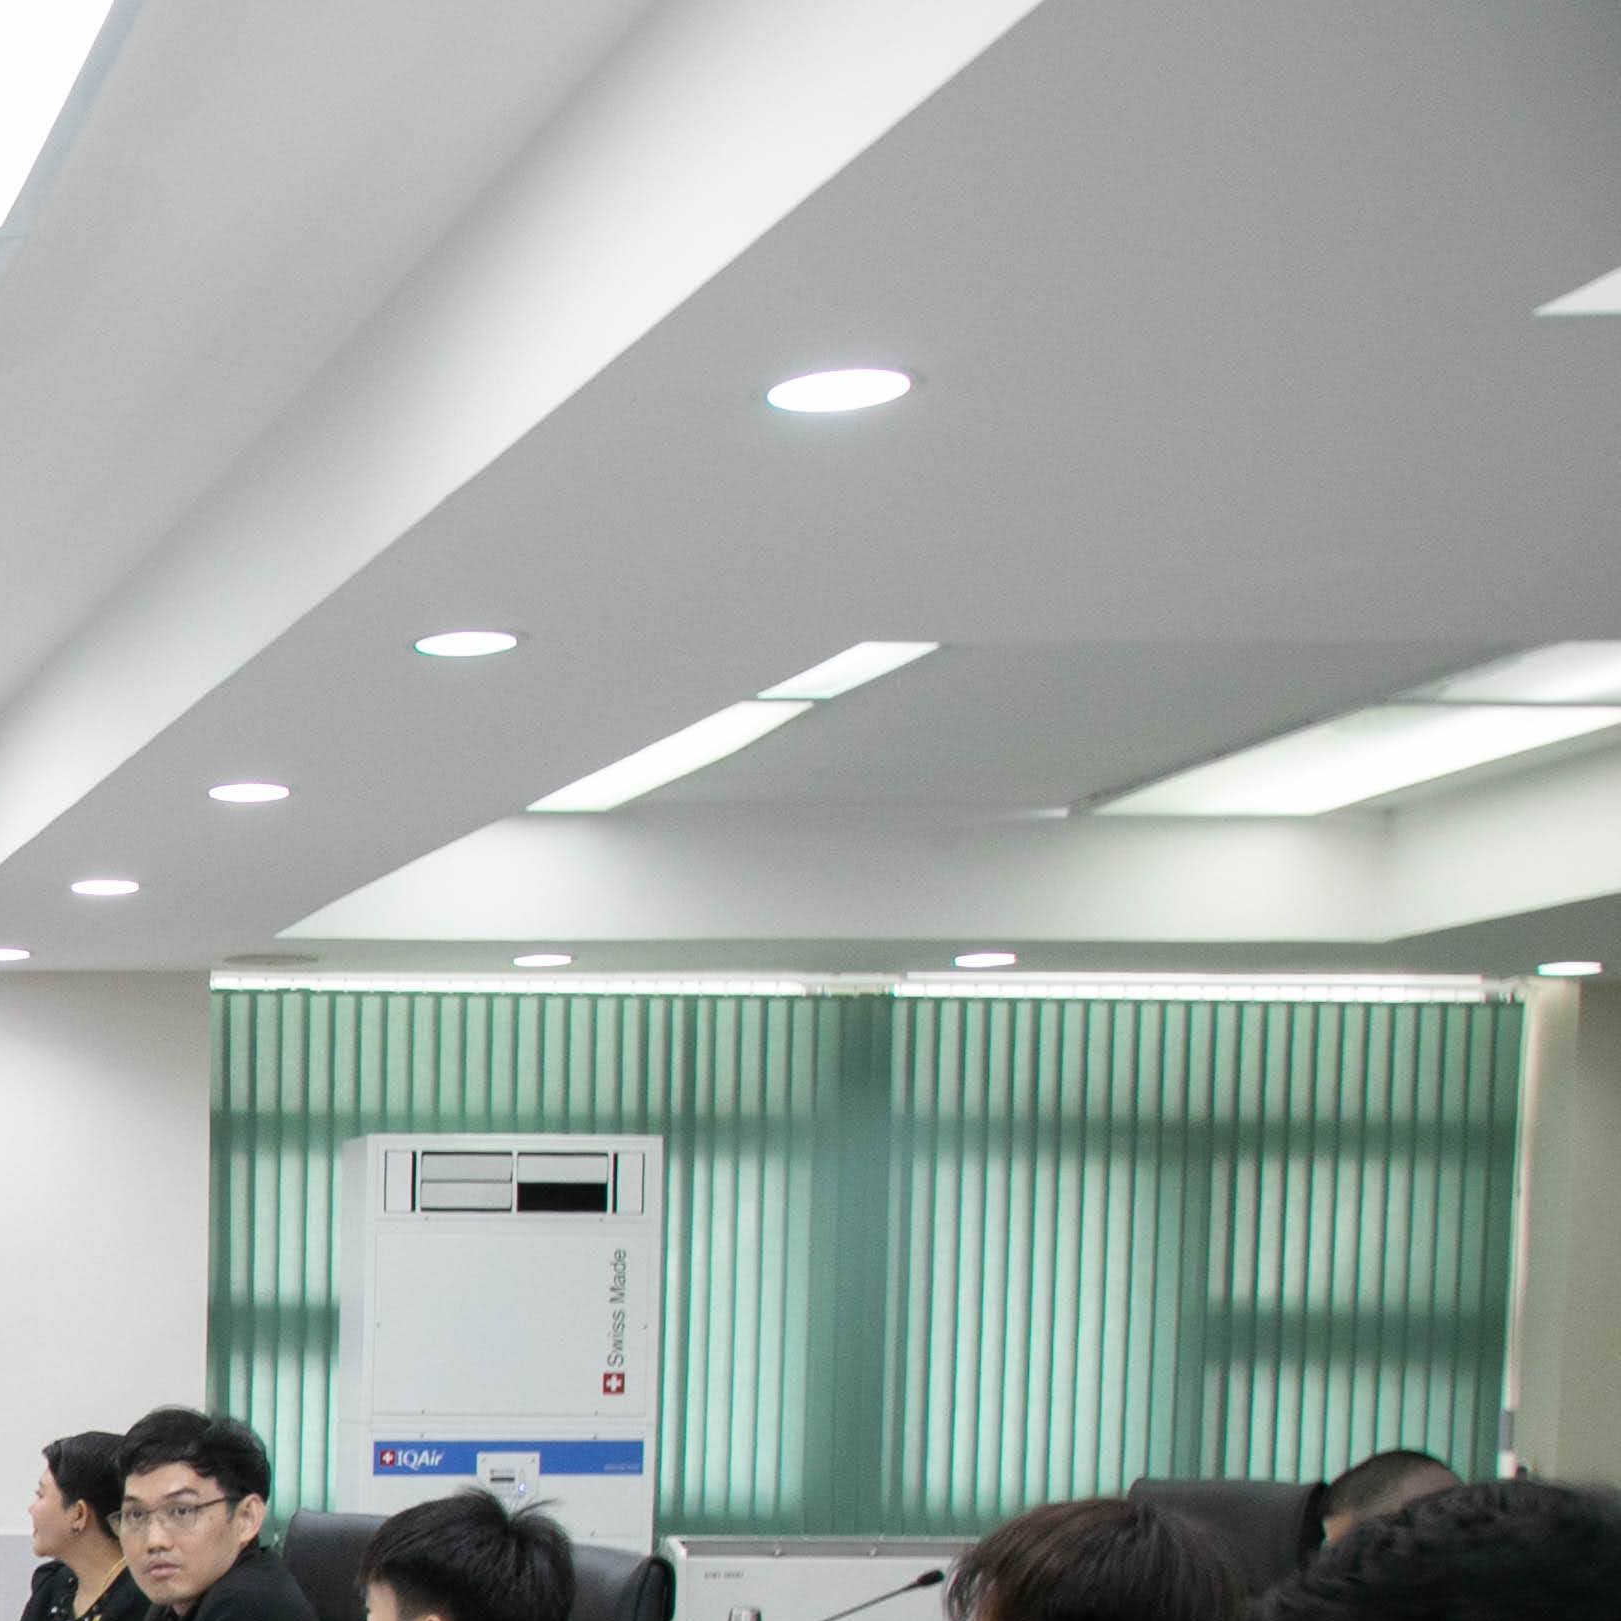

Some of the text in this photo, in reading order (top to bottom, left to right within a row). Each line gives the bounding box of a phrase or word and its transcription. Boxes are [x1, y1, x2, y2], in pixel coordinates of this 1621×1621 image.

[607, 1248, 627, 1368] Swiss Made
[397, 1450, 444, 1469] IQAir
